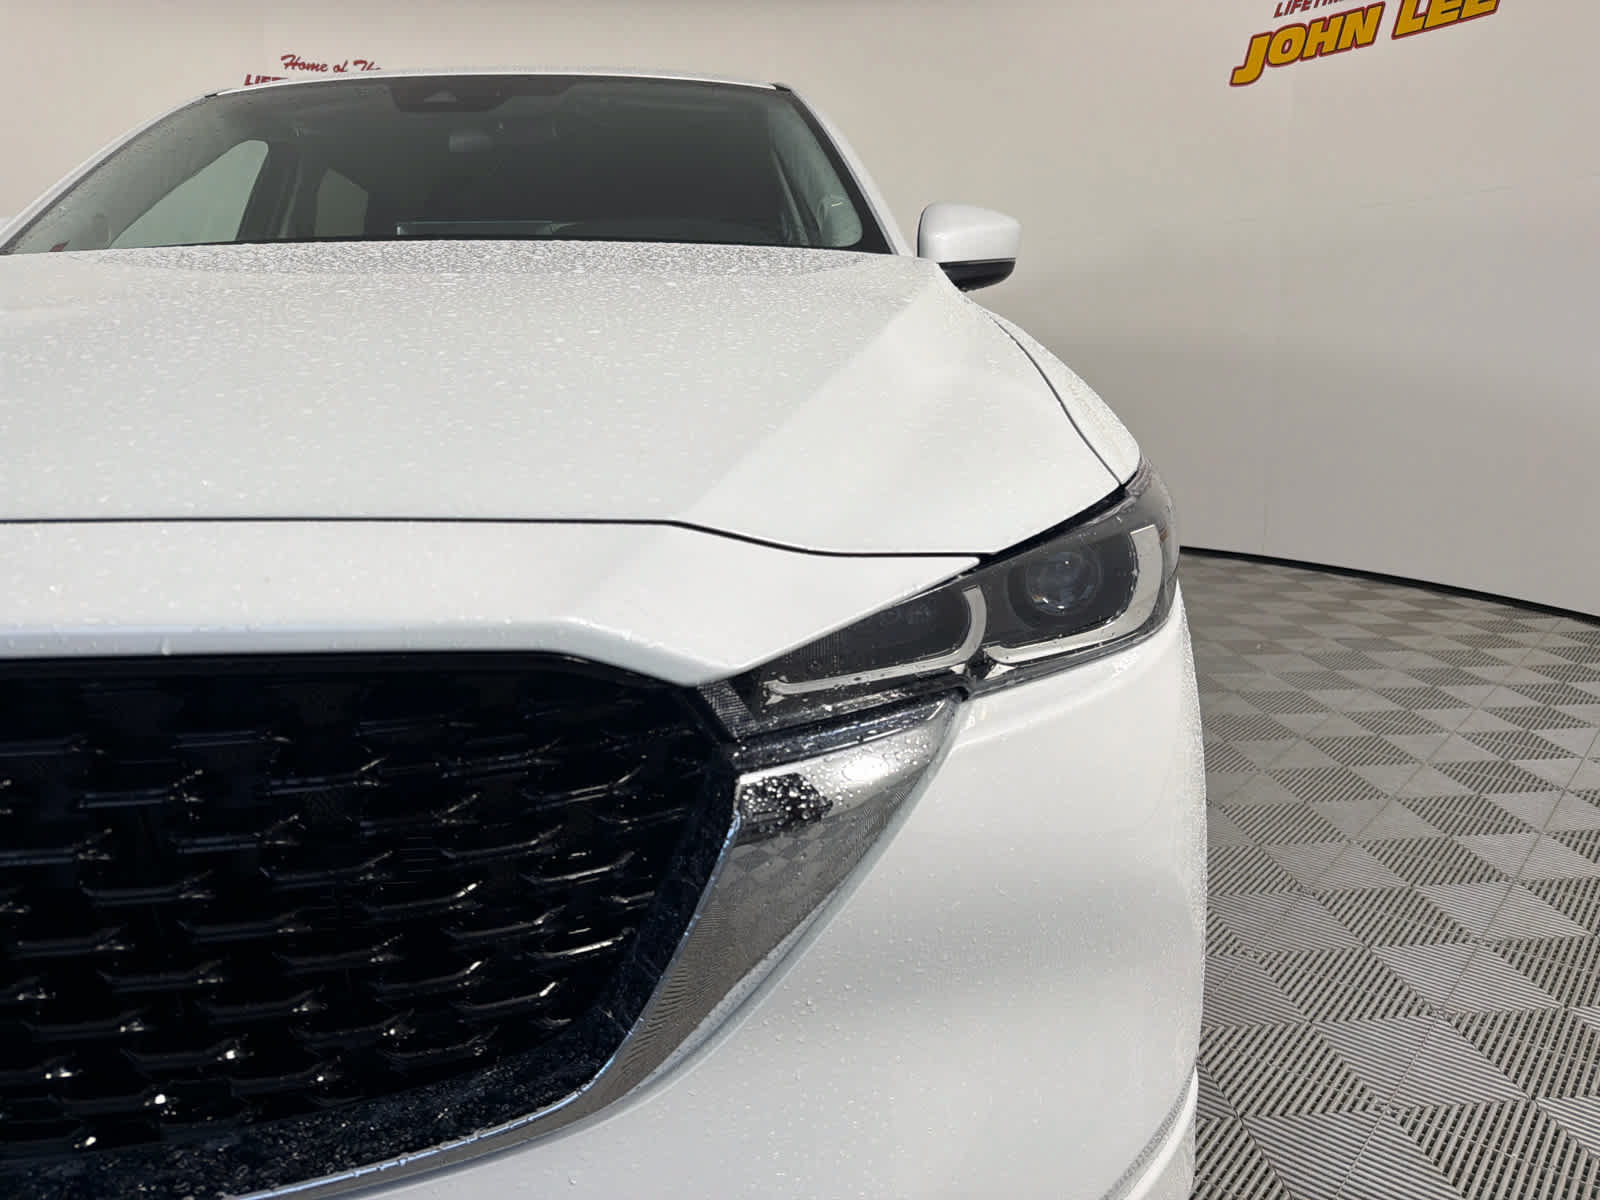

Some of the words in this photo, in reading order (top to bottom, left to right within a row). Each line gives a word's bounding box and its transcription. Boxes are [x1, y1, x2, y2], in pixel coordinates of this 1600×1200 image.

[1273, 0, 1343, 18] LIFE
[1229, 1, 1386, 87] JOHN
[280, 54, 328, 72] Home
[353, 60, 381, 71] Th
[244, 74, 288, 86] LIF
